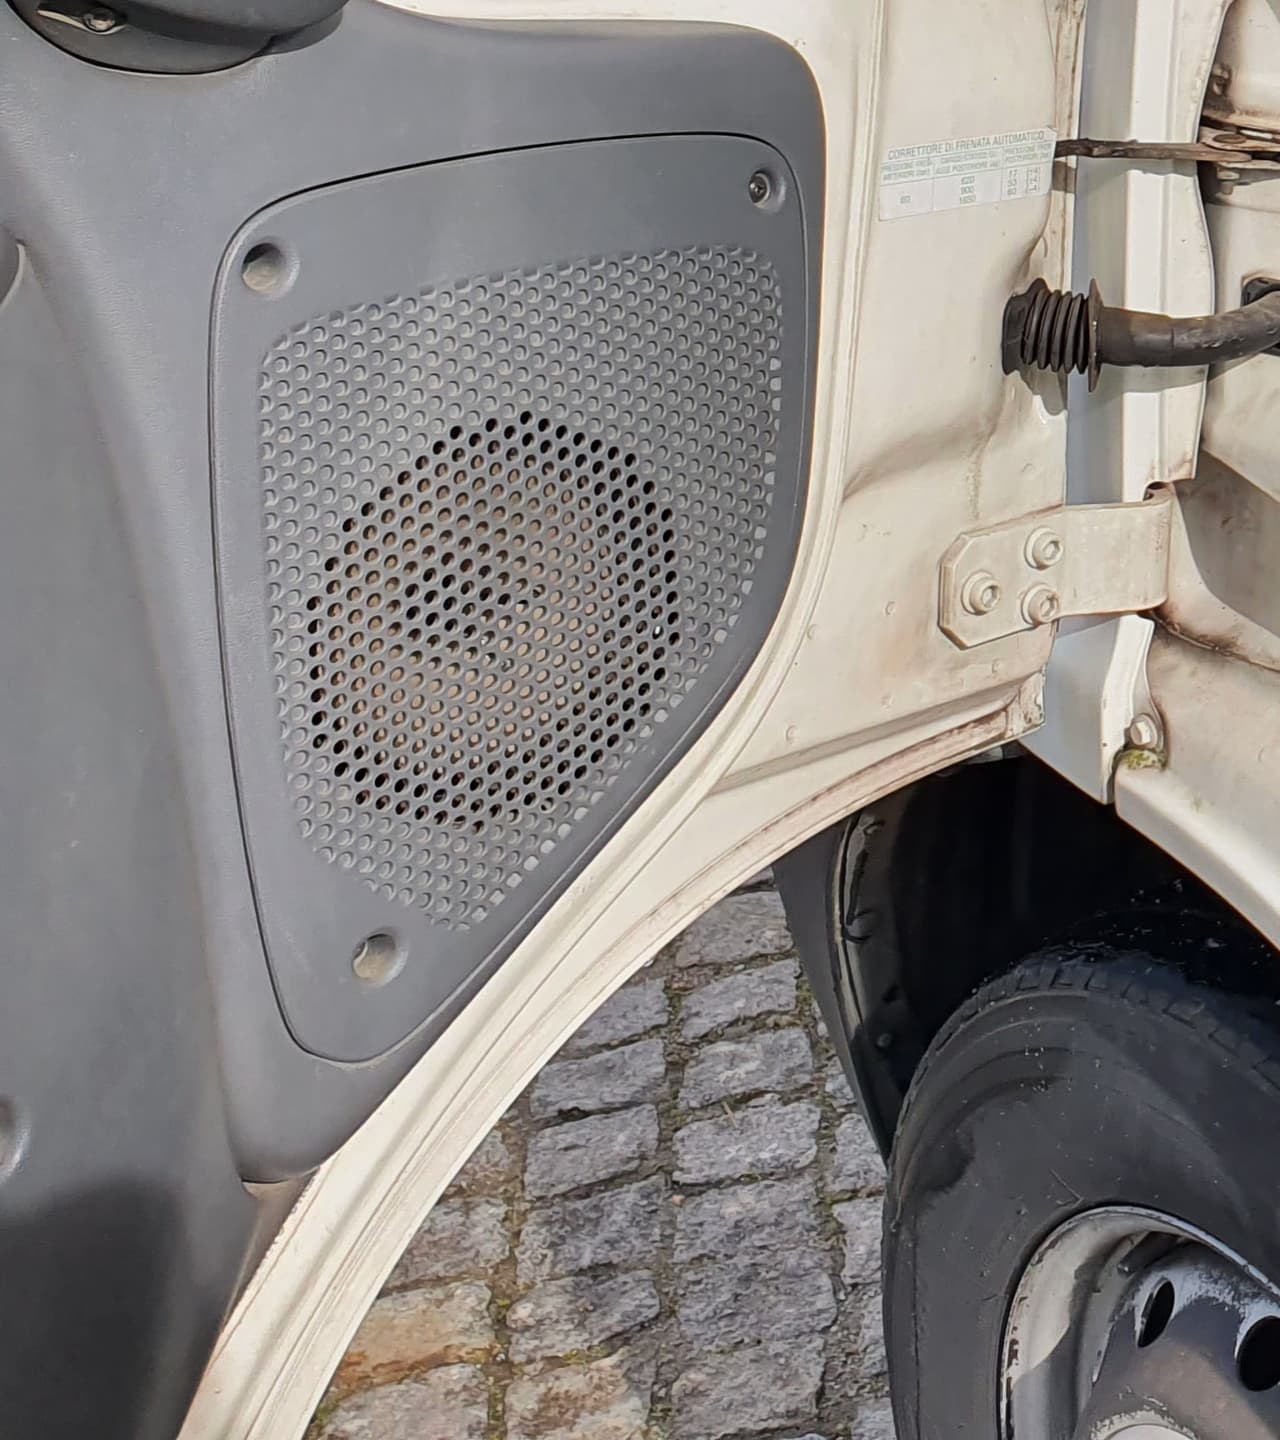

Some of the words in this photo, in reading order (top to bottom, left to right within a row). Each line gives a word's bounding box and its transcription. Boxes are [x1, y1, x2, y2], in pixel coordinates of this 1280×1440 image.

[888, 143, 943, 160] CORRETTORE
[945, 141, 955, 153] DI
[956, 136, 992, 152] FRENATA
[992, 130, 1045, 145] AUTOMATICO
